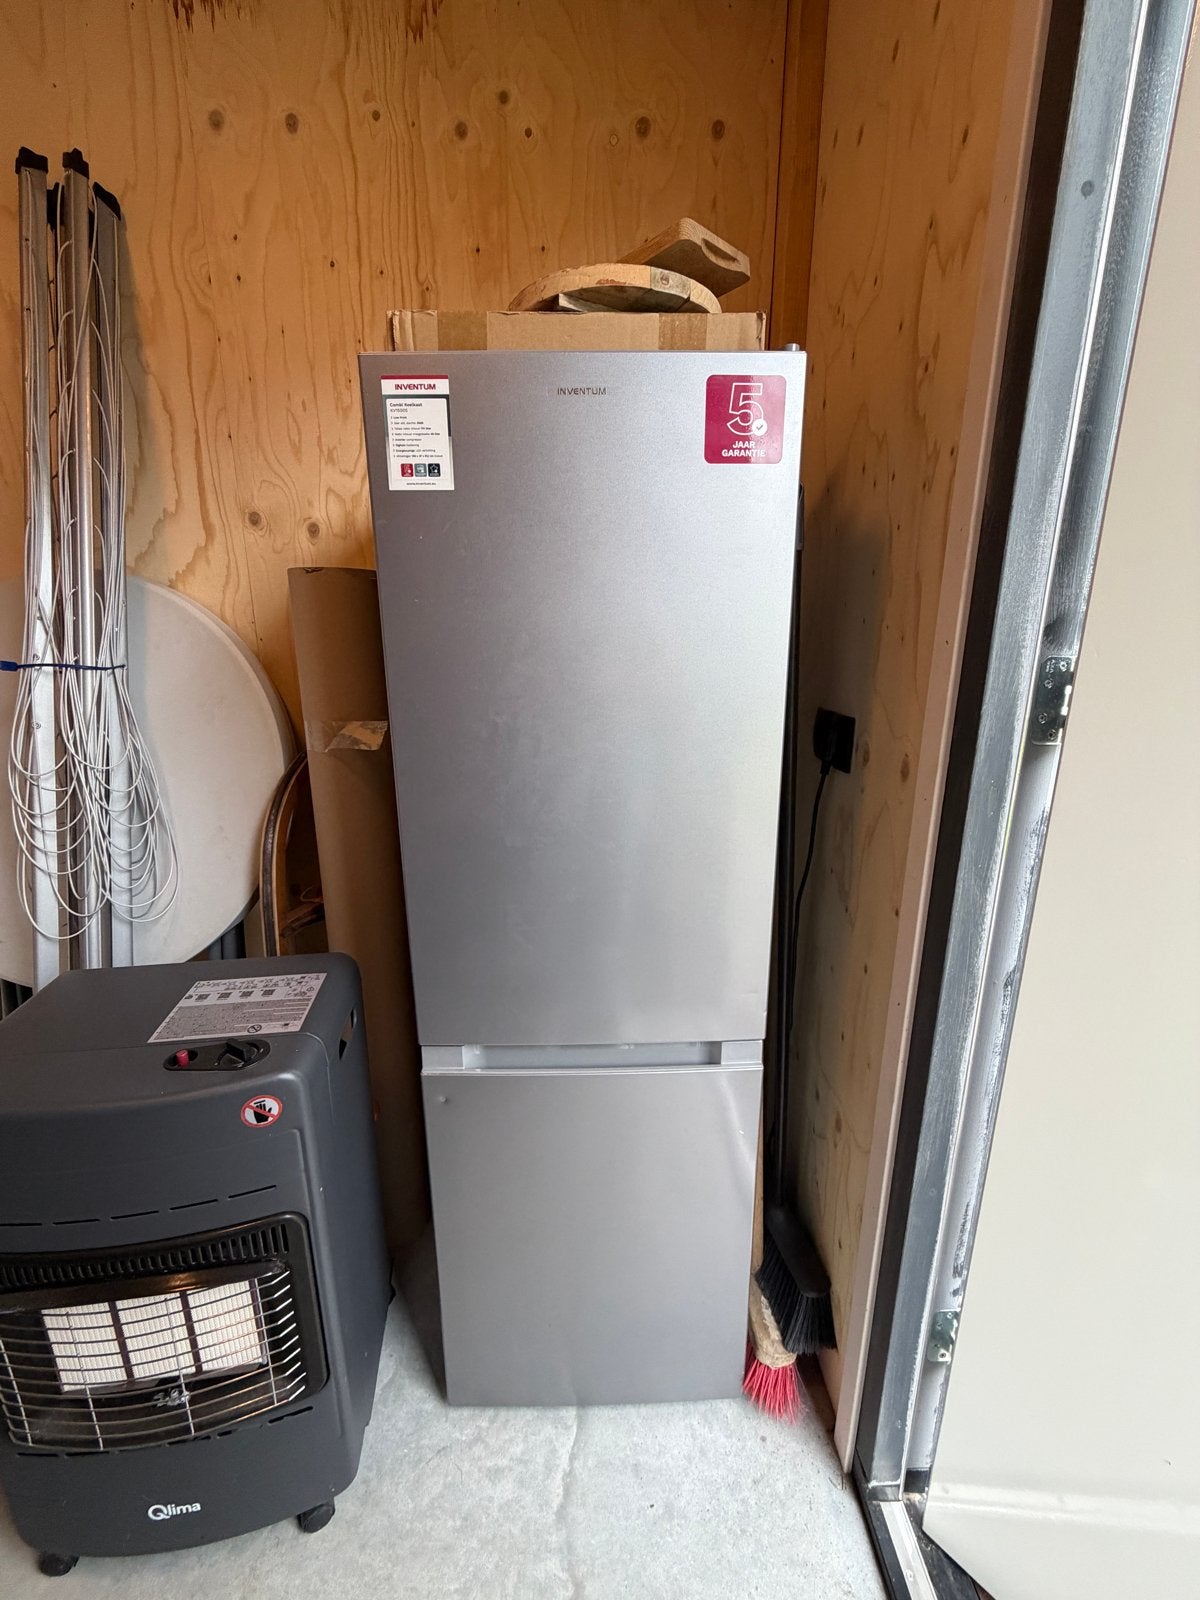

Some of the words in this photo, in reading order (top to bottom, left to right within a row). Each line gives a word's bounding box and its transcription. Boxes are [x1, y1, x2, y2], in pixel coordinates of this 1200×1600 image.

[394, 383, 436, 391] INVENTUM
[557, 387, 607, 396] INVENTUM
[726, 382, 764, 436] 5
[732, 440, 756, 449] JAAR
[721, 449, 766, 457] GARANTIE
[147, 1503, 202, 1521] Qlima
